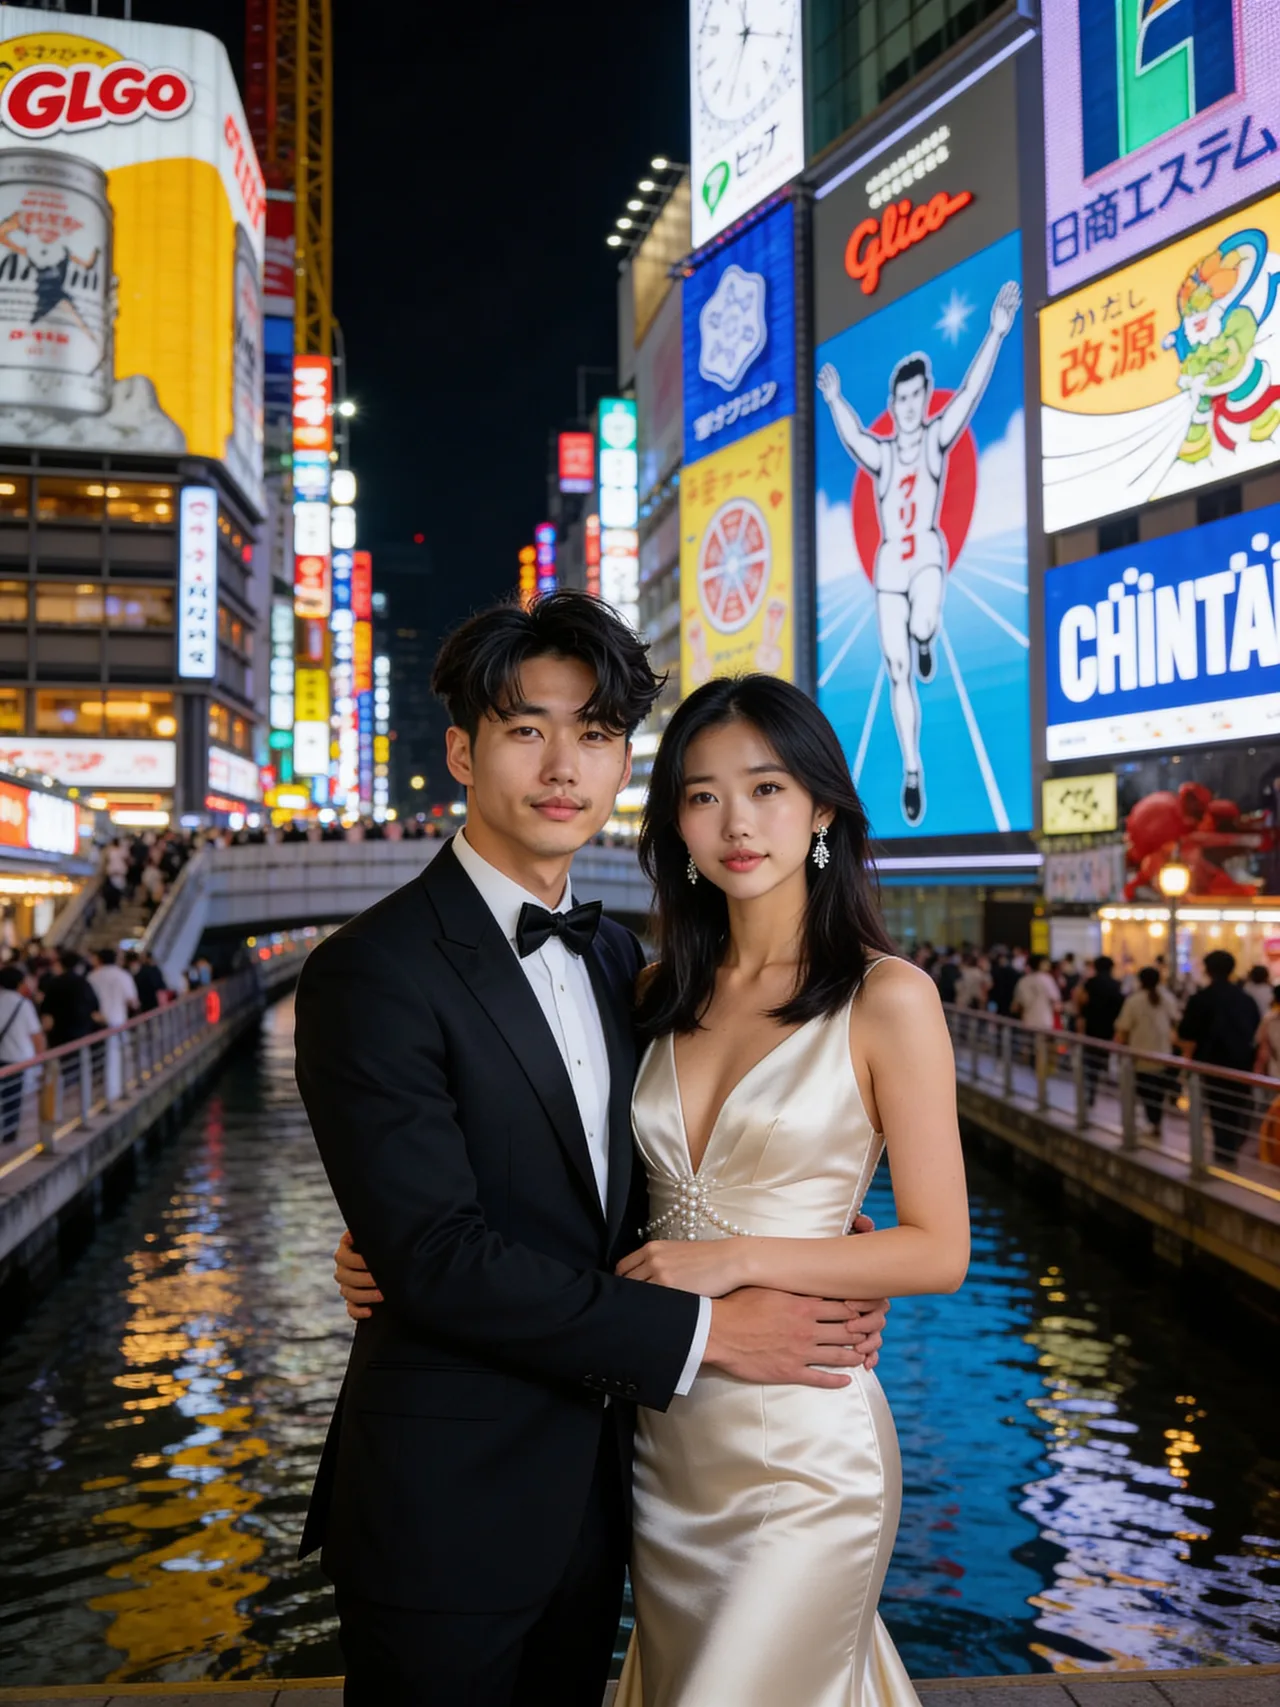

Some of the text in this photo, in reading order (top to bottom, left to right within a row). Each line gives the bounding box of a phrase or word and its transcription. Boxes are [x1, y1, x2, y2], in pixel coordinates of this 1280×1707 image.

[8, 67, 187, 129] GLGO
[1052, 115, 1278, 267] 日商エステム
[845, 191, 973, 295] Glico
[1060, 309, 1156, 400] 改源
